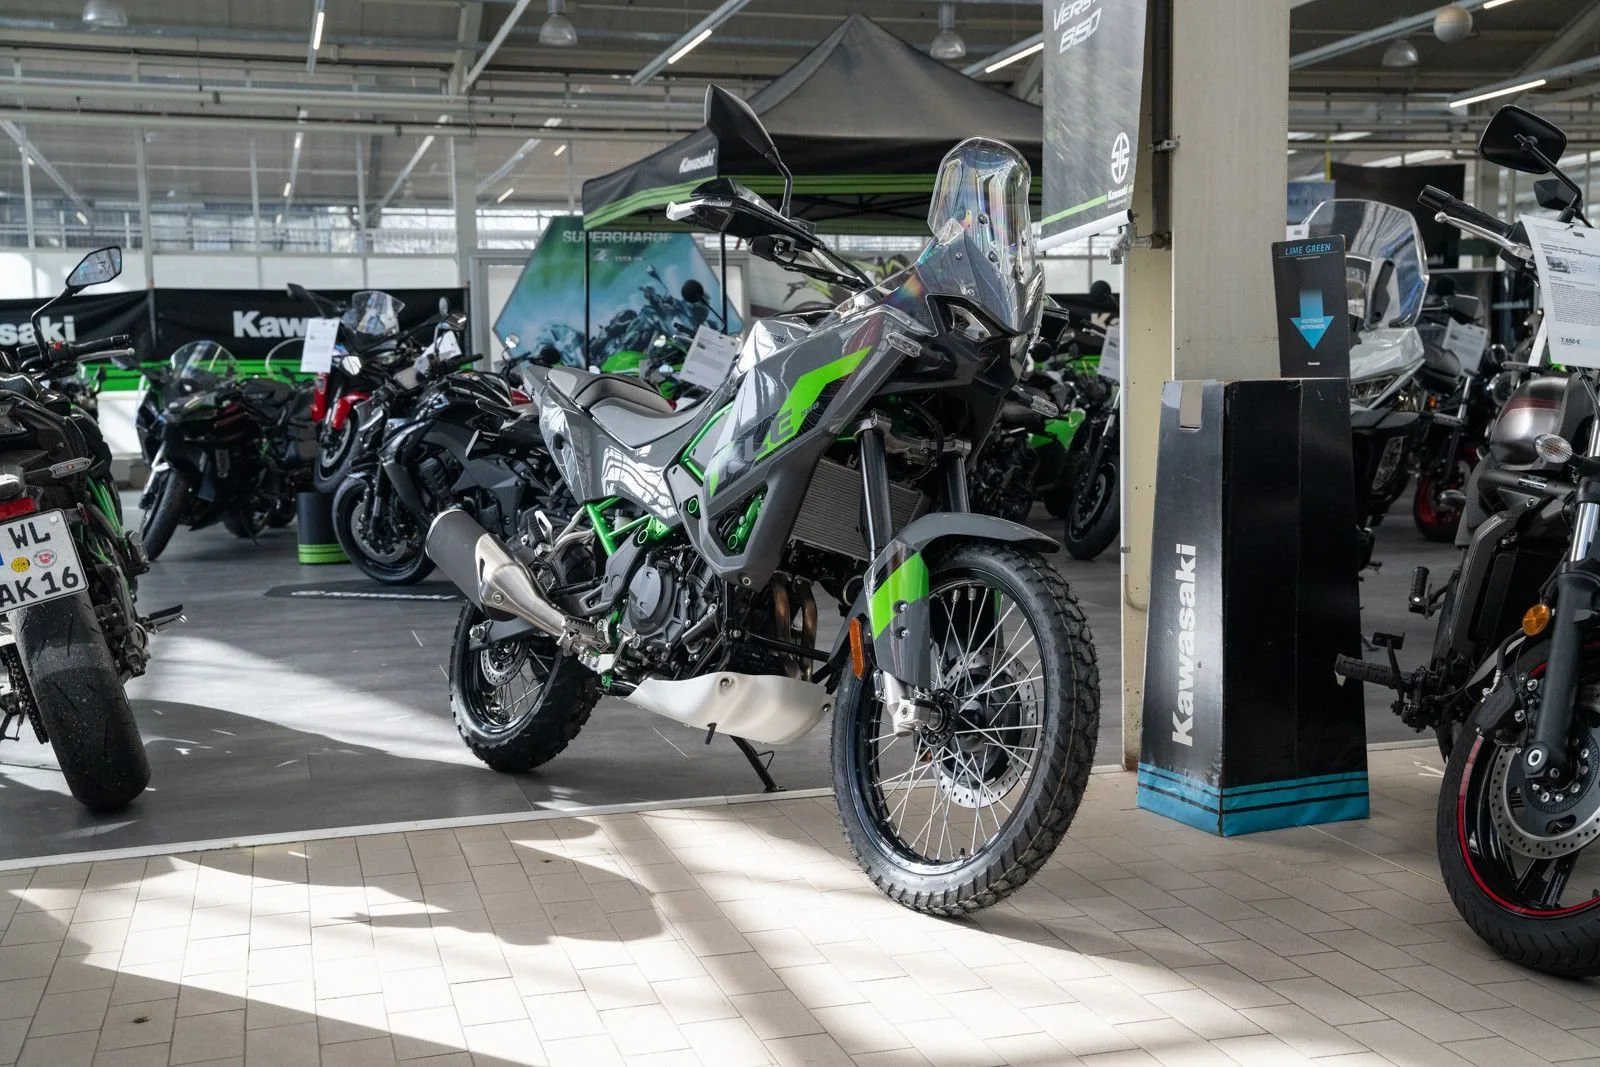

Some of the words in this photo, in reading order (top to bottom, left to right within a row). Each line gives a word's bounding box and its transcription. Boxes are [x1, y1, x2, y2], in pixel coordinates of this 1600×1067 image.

[1059, 7, 1102, 54] 650
[1285, 246, 1303, 256] LIME
[1305, 243, 1332, 254] GREEN
[7, 522, 52, 549] WL
[41, 566, 79, 595] 16
[1172, 543, 1196, 747] Kawasaki
